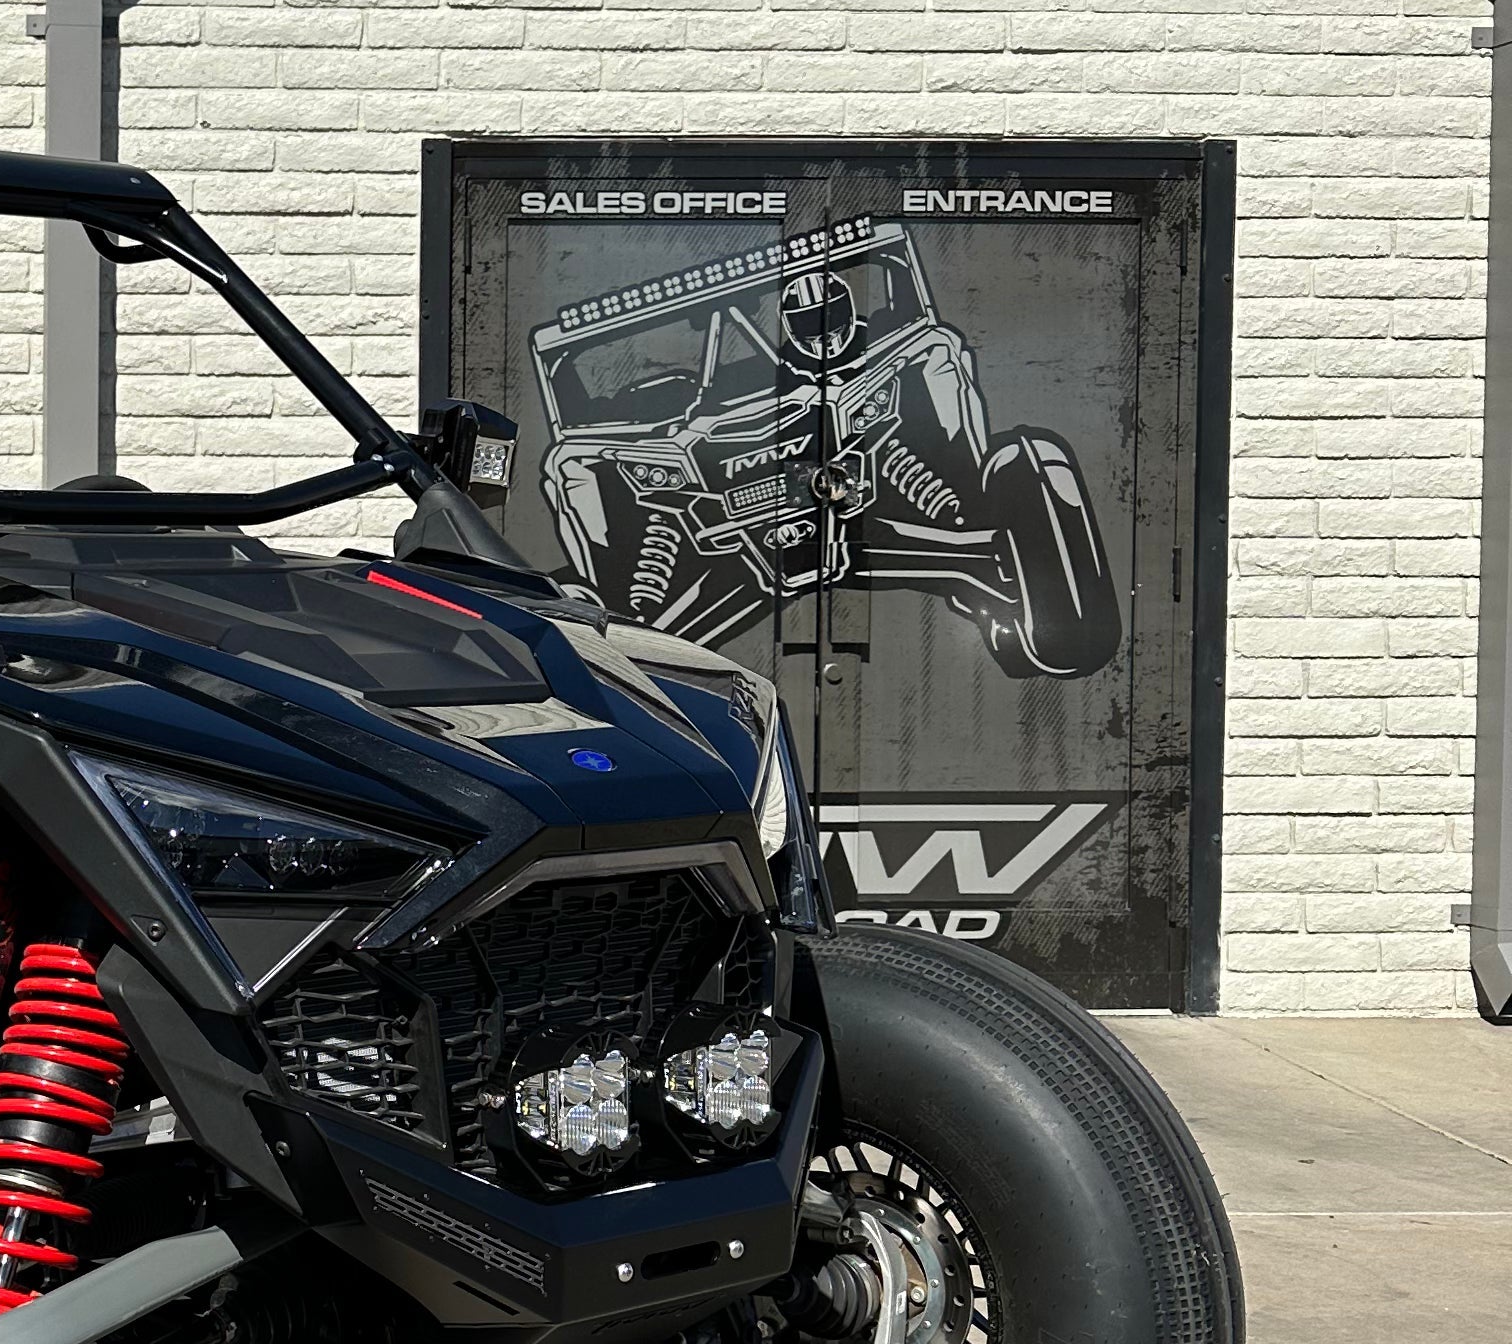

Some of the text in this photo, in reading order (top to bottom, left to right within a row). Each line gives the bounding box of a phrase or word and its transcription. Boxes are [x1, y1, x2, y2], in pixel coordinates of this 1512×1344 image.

[520, 189, 1113, 215] SALES OFFICE ENTRANCE
[719, 433, 814, 480] TMW
